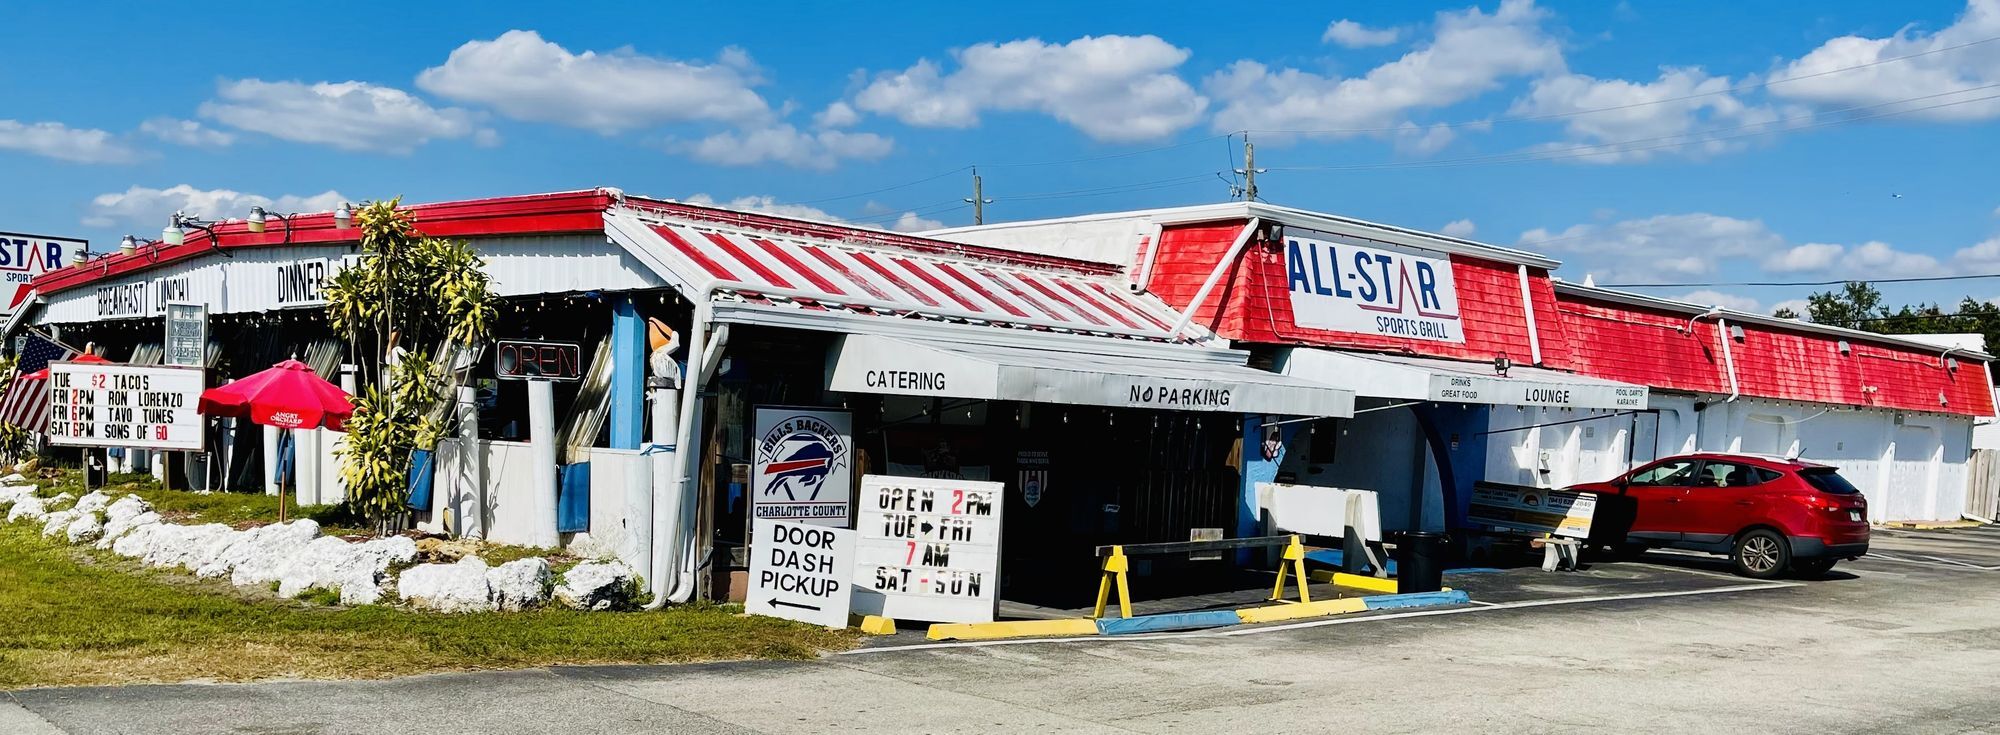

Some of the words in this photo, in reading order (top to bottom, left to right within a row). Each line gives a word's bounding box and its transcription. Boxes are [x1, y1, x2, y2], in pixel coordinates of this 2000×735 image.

[278, 262, 324, 303] DINNER
[1289, 240, 1442, 314] ALL-STAR
[98, 284, 144, 316] BREAKFAST
[1377, 316, 1417, 335] SPORTS
[1419, 321, 1448, 338] GRILL
[501, 345, 576, 376] OPEN
[53, 373, 70, 387] TUE
[92, 374, 105, 388] $2
[114, 375, 148, 390] TACOS
[867, 371, 945, 390] CATERING
[1451, 378, 1471, 386] DRINKS
[53, 389, 68, 404] FRI
[72, 389, 94, 405] 2PM
[109, 391, 127, 406] RON
[139, 392, 182, 407] LORENZO
[1130, 385, 1153, 402] NO
[1159, 387, 1230, 406] PARKING
[1526, 388, 1570, 403] LOUNGE
[53, 406, 67, 420] FRI
[72, 406, 94, 421] 6PM
[108, 408, 132, 422] TAVO
[143, 409, 173, 423] TUNES
[270, 416, 303, 424] ORCHARD
[52, 422, 70, 436] SAT
[105, 424, 129, 439] SONS
[137, 425, 148, 439] OF
[156, 425, 167, 440] 60
[763, 423, 793, 454] BILLS
[796, 420, 842, 454] BACKERS
[756, 506, 810, 517] CHARLOTTE
[813, 505, 847, 516] COUNTY
[879, 487, 934, 512] OPEN
[774, 524, 836, 550] DOOR
[883, 514, 917, 538] TUE
[940, 518, 972, 542] FRI
[771, 548, 834, 574] DASH
[760, 570, 839, 598] PICKUP
[875, 566, 912, 592] SAT
[935, 570, 981, 597] SUN
